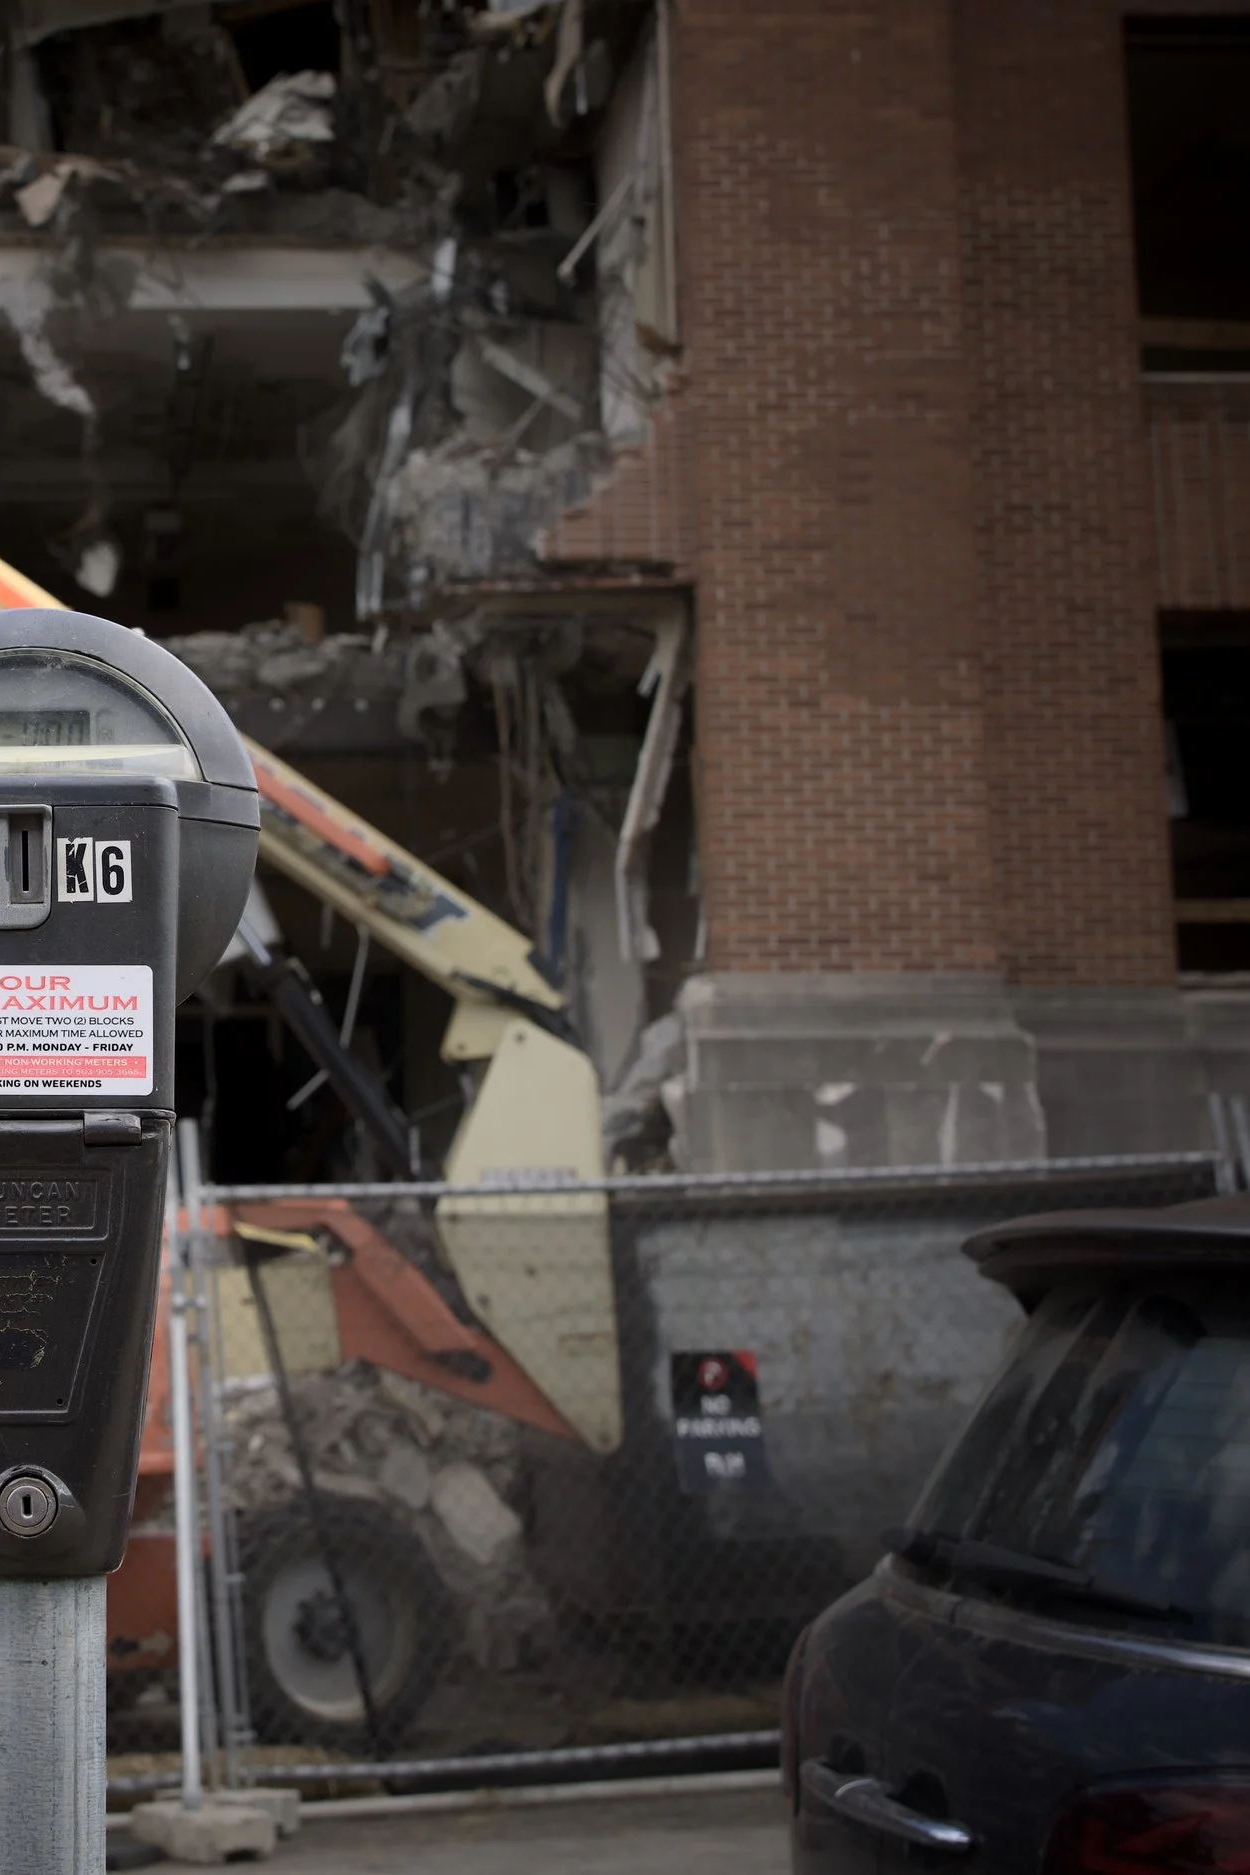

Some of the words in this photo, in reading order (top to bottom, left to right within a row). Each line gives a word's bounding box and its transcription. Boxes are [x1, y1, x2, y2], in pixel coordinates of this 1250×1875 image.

[10, 1017, 43, 1025] MOVE
[45, 1017, 72, 1025] TWO
[73, 1017, 86, 1026] (2)
[89, 1017, 134, 1025] BLOCKS
[7, 1043, 29, 1051] P.M.
[33, 1043, 82, 1052] MONDAY
[93, 1043, 134, 1052] FRIDAY
[5, 1058, 82, 1066] NON-WORKING
[85, 1058, 128, 1067] METERS
[24, 1080, 39, 1088] ON
[42, 1080, 102, 1088] WEEKENDS
